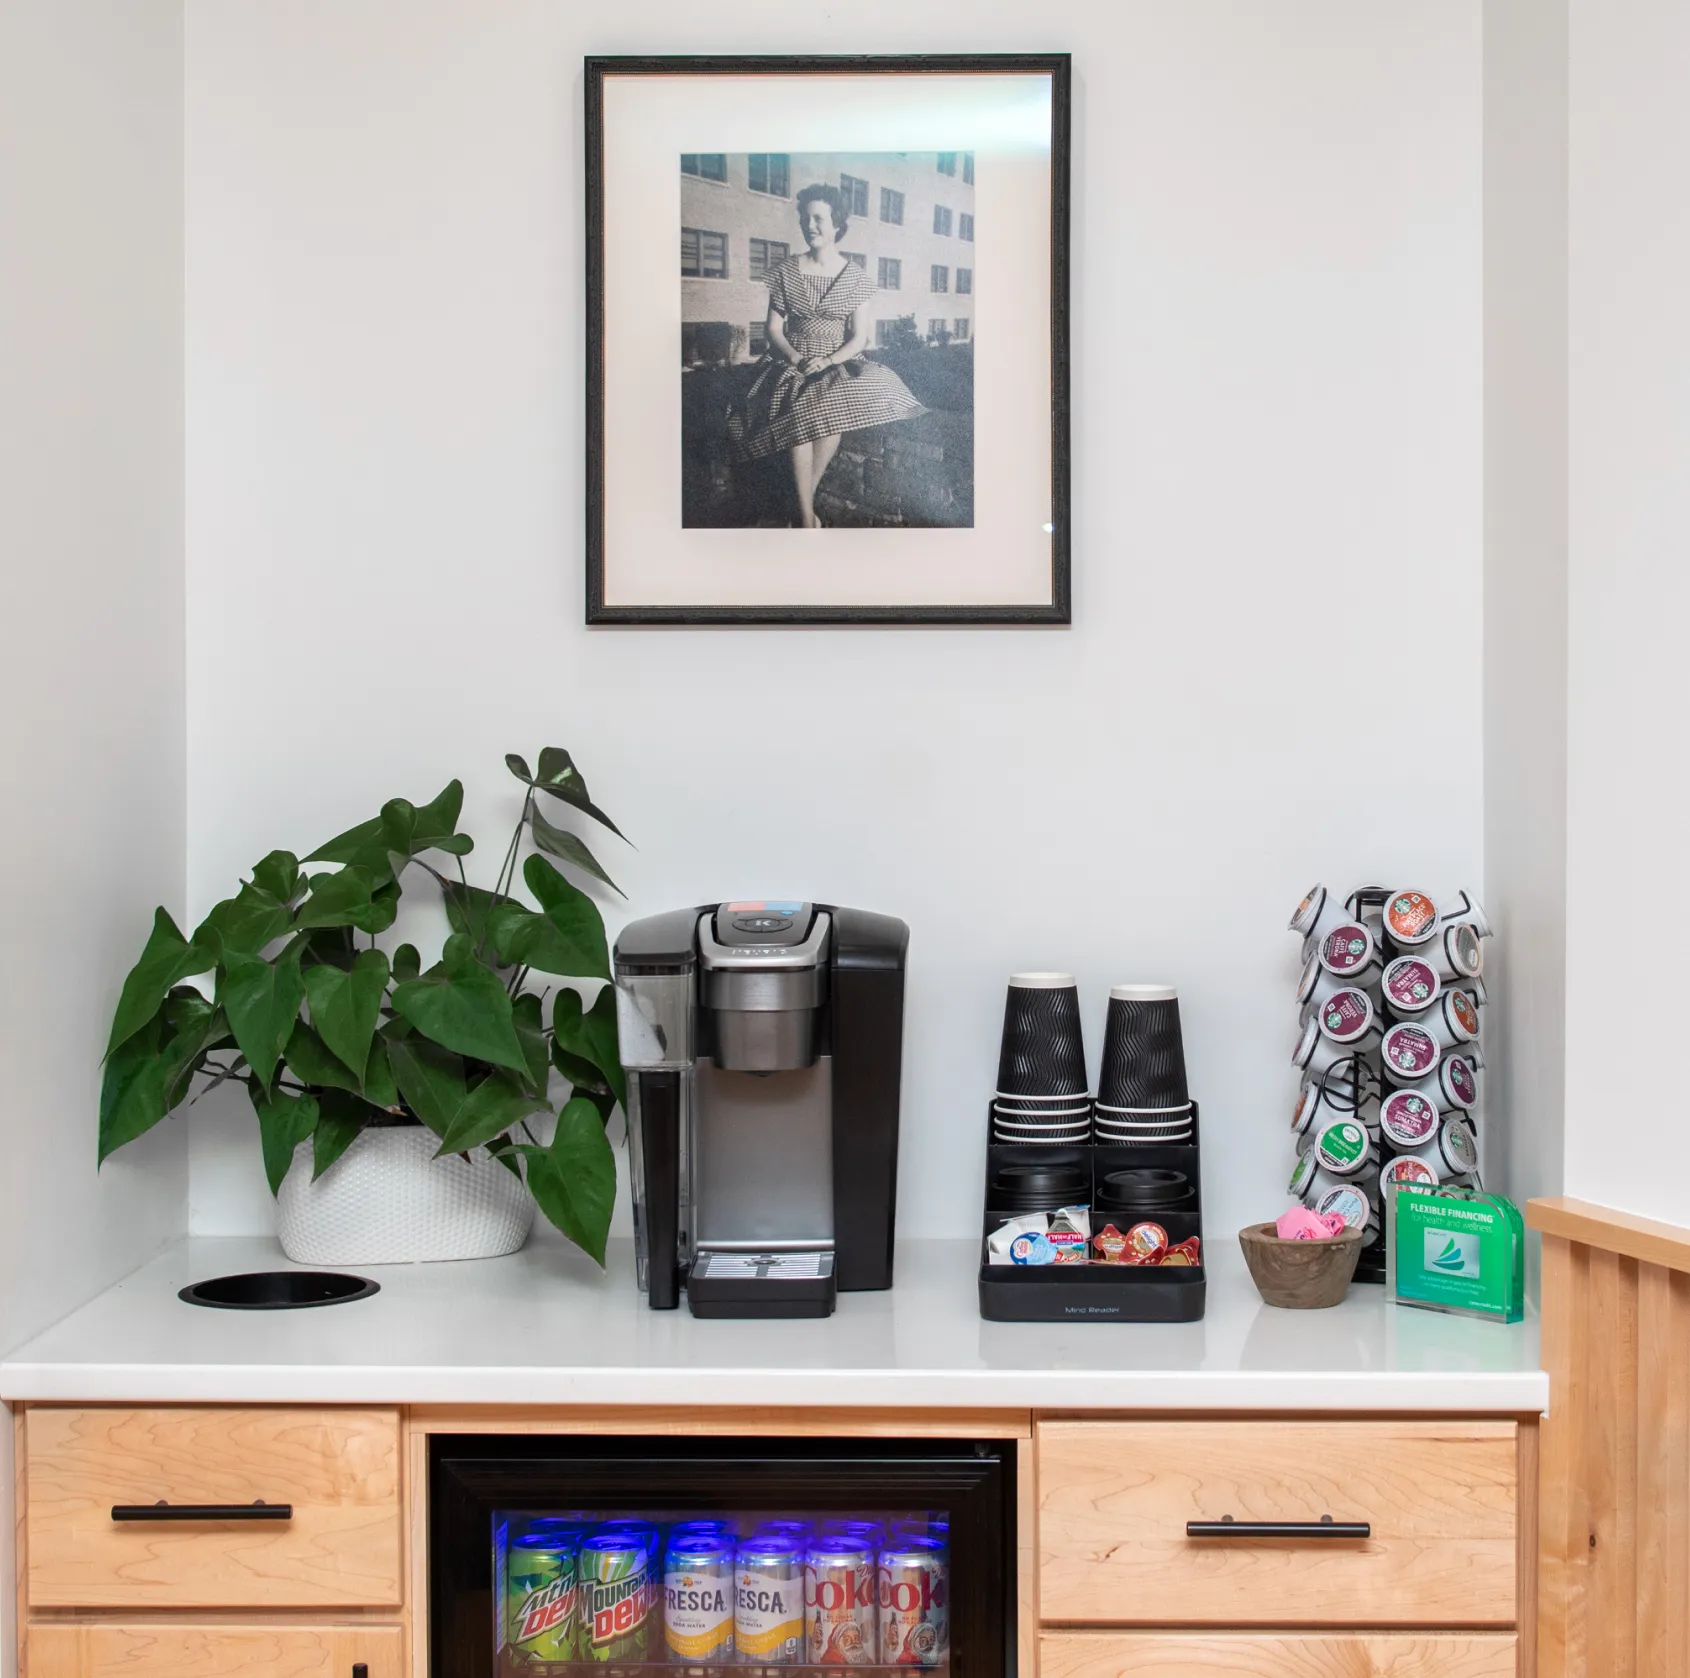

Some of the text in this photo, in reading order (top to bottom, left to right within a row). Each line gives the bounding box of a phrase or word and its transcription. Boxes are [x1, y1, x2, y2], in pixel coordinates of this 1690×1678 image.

[1333, 936, 1342, 957] VERONA
[1395, 967, 1418, 988] SUMATRA
[1343, 999, 1358, 1017] VERONA
[1399, 1037, 1427, 1050] SUMATRA
[1394, 1113, 1421, 1128] SUMATRA
[1410, 1203, 1493, 1224] FLEXIBLE FINANCING
[1412, 1213, 1421, 1222] for
[1423, 1214, 1445, 1226] health
[1446, 1218, 1460, 1228] and
[1141, 1230, 1157, 1248] delight
